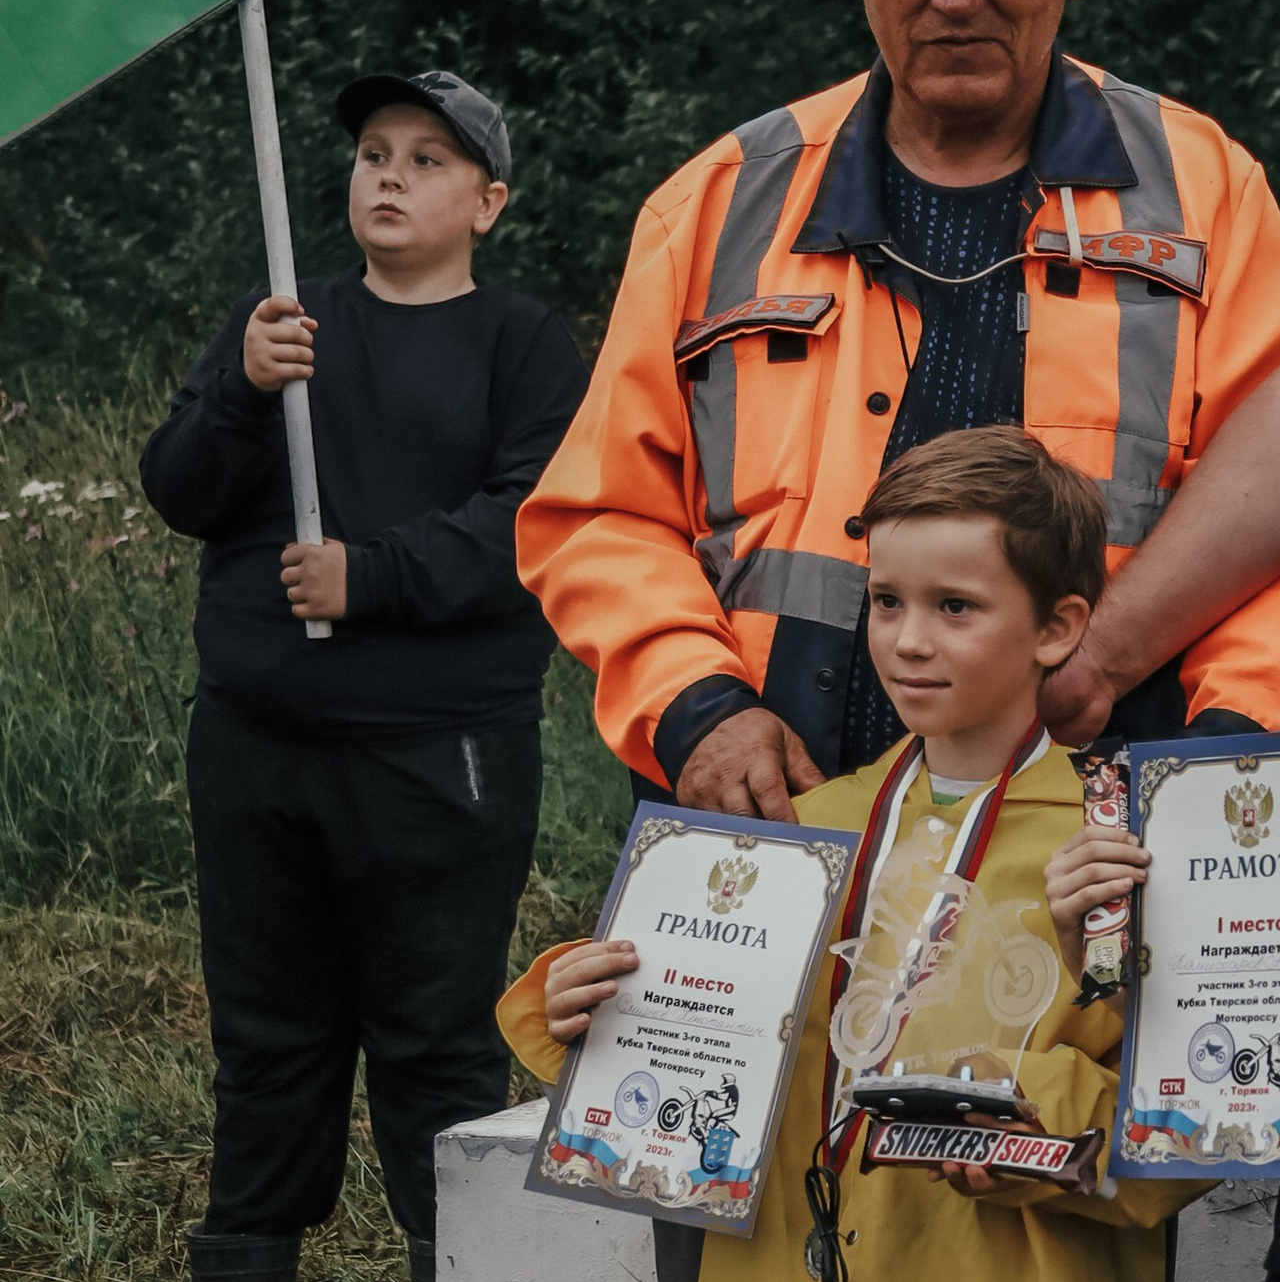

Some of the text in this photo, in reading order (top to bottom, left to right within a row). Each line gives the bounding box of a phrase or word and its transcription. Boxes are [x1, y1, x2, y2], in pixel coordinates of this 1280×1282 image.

[654, 911, 768, 950] ГРАМОТА
[663, 968, 735, 995] II место
[1198, 980, 1245, 993] участник
[1248, 979, 1268, 989] 3-го
[643, 990, 735, 1017] Награждается
[1177, 998, 1206, 1010] Кубка
[1210, 995, 1259, 1009] Тверской
[1215, 1013, 1278, 1025] Мотокроссу
[637, 1025, 731, 1050] участник 3-го этапа
[616, 1035, 747, 1068] Кубка Тверской области по
[649, 1058, 706, 1078] Мотокроссу
[1160, 1081, 1182, 1094] СТК
[1231, 1085, 1270, 1097] Торжок
[1159, 1098, 1202, 1111] ТОРЖОК
[1227, 1102, 1260, 1113] 2023г.
[587, 1110, 609, 1125] СТК
[581, 1126, 624, 1144] ТОРЖОК
[652, 1128, 688, 1144] Торжок
[645, 1144, 676, 1158] 2023г.
[879, 1123, 1070, 1169] SNICKERS SUPER
